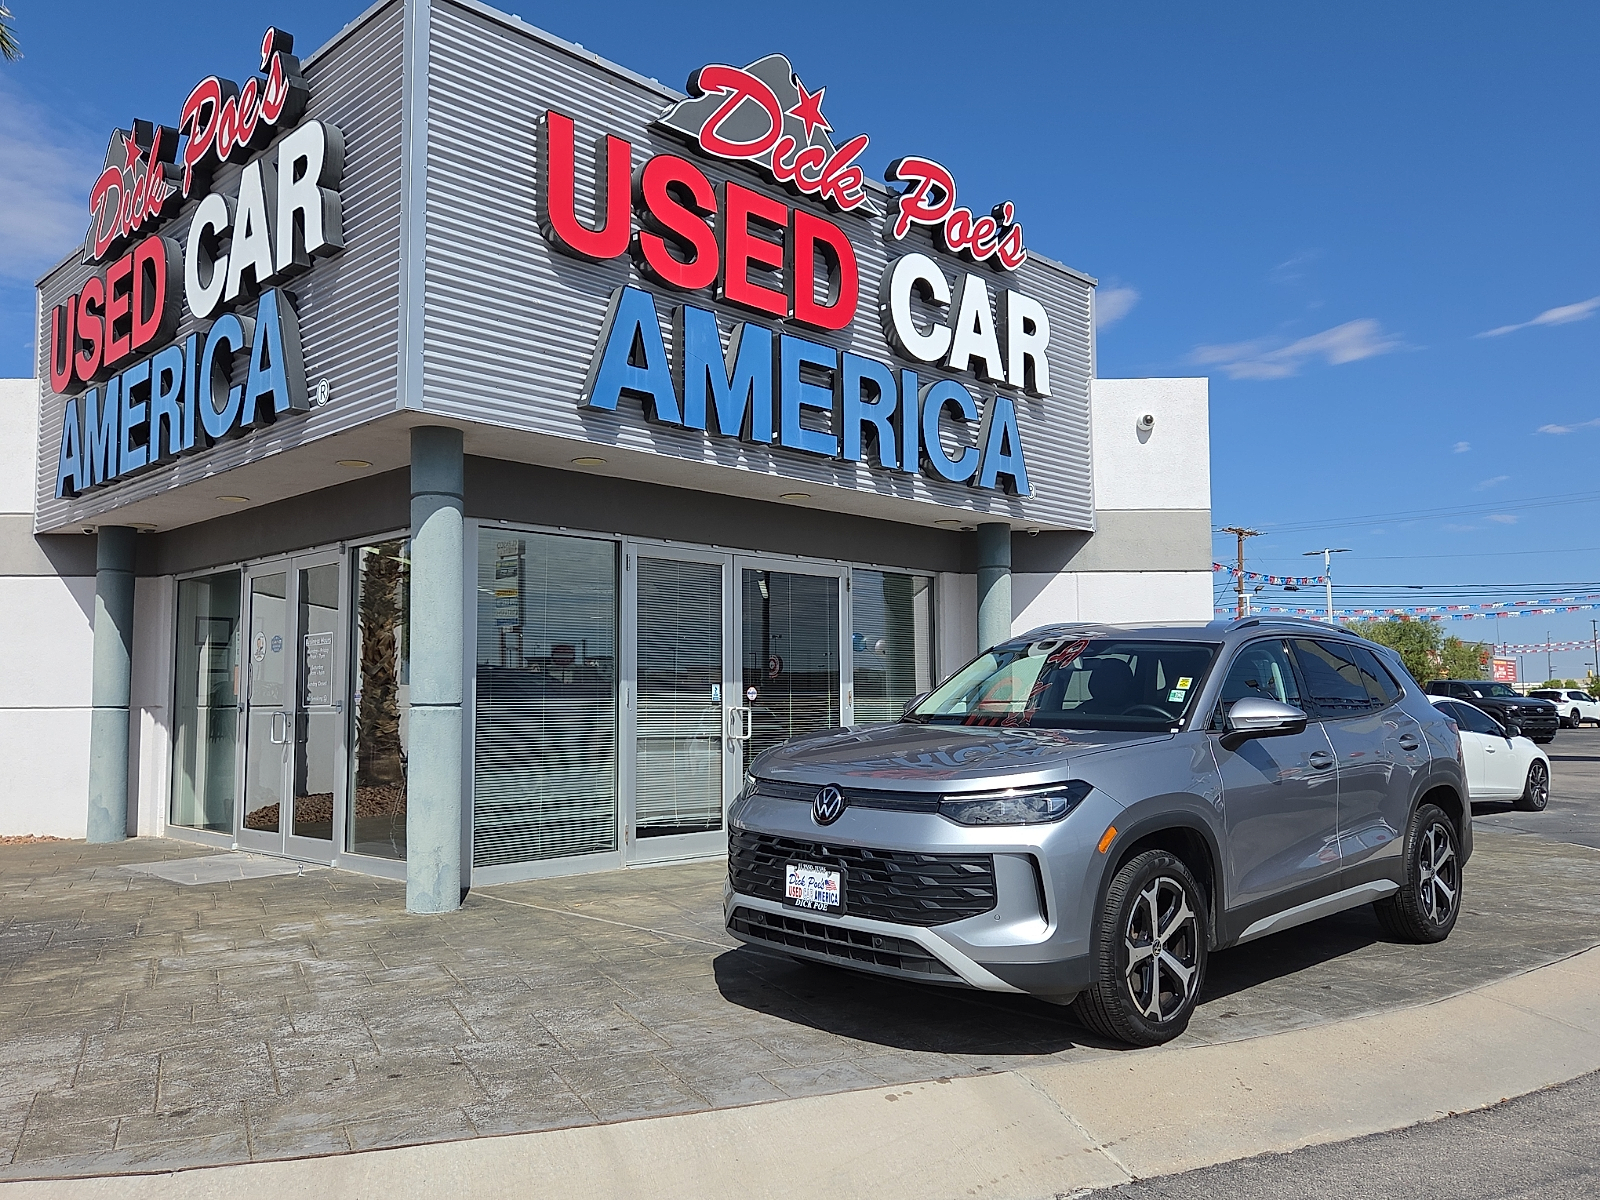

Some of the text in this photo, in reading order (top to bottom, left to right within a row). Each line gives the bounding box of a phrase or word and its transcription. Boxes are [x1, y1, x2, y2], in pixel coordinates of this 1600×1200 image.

[89, 26, 292, 261] Dick Poe's
[698, 63, 1028, 271] Dick Poe's
[49, 119, 326, 394] USED CAR
[546, 110, 1052, 397] USED CAR
[55, 288, 291, 499] AMERICA
[588, 285, 1031, 497] AMERICA
[788, 874, 806, 887] Dick
[788, 886, 803, 898] USED
[814, 890, 838, 905] AMERICA
[795, 899, 828, 912] DICK POE
